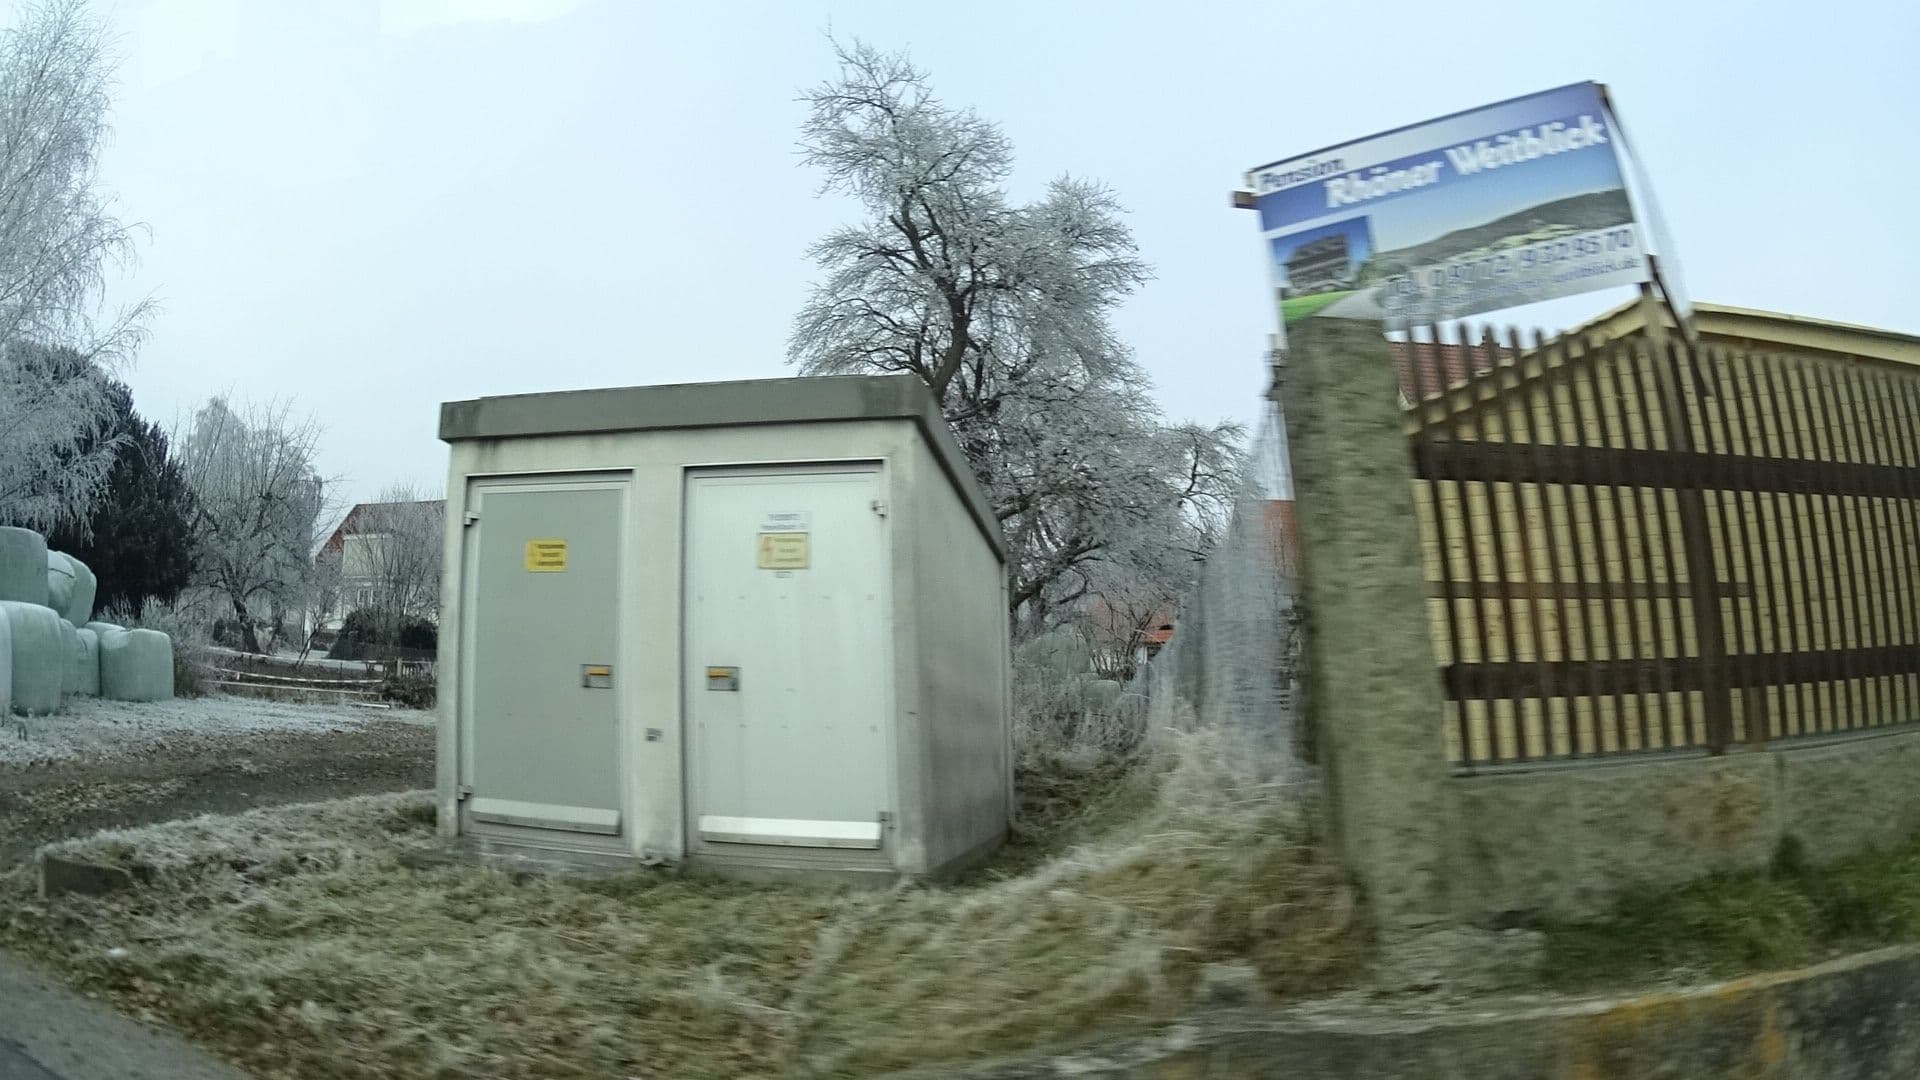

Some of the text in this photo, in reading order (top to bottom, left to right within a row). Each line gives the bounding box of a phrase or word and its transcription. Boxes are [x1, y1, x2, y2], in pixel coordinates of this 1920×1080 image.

[1259, 157, 1345, 192] Pension
[1325, 115, 1609, 208] Rhöner Weitblick
